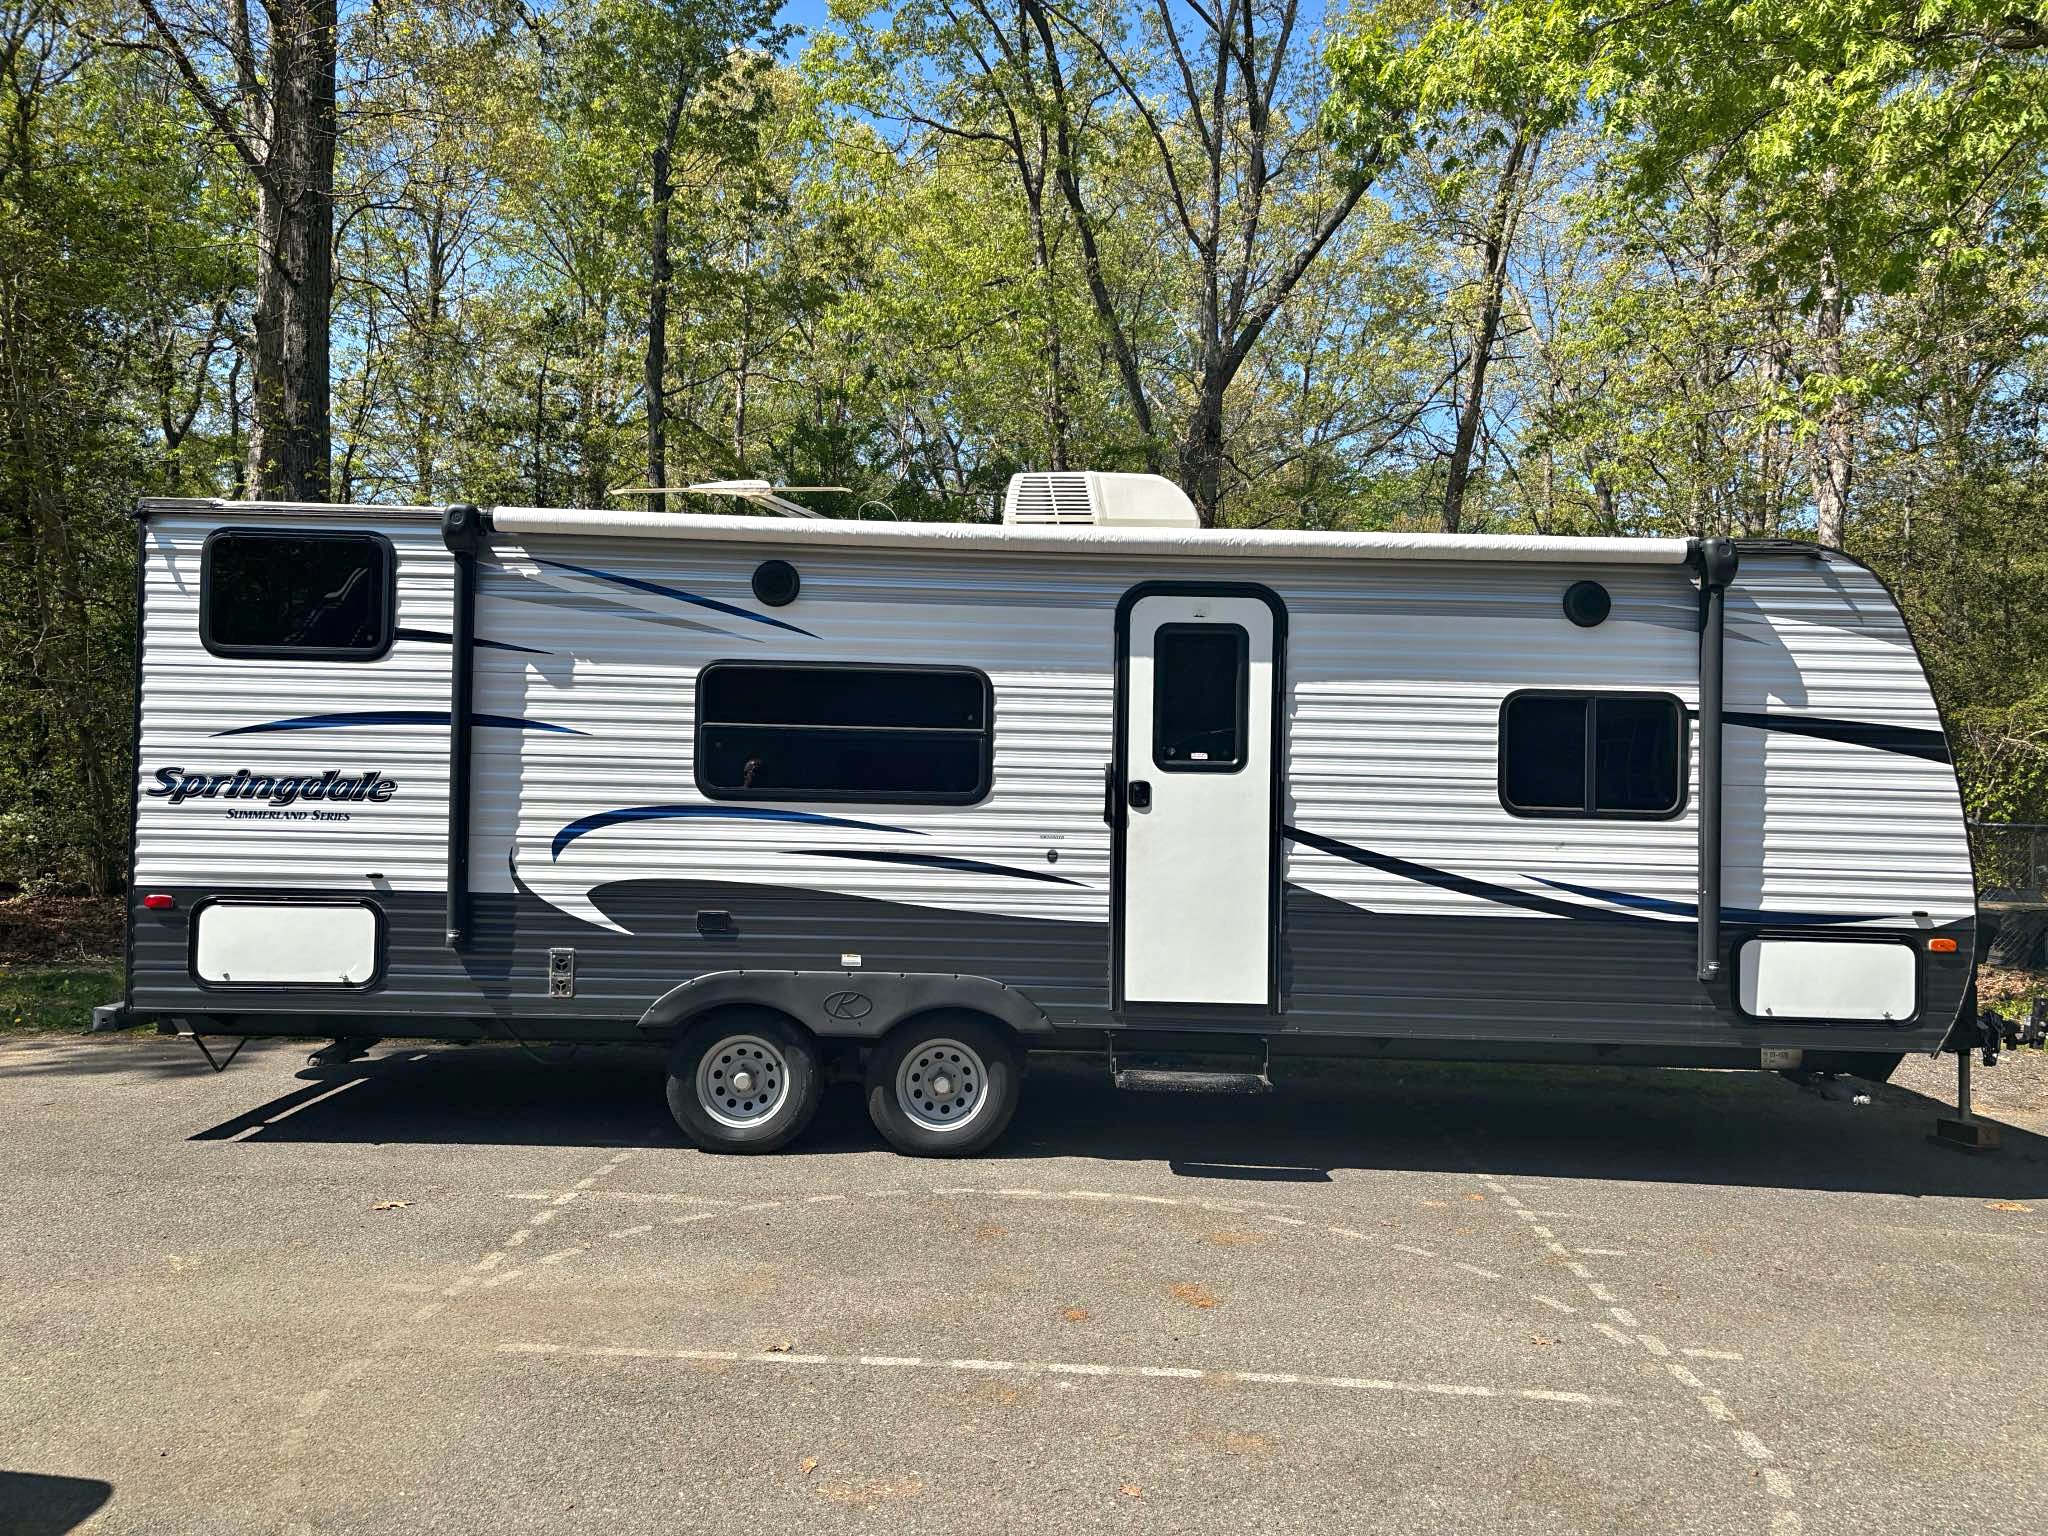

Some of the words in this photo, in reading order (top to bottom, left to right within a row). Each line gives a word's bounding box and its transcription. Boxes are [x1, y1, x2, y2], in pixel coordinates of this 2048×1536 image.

[146, 767, 398, 806] Springdale
[225, 808, 308, 820] SUMMERLAND
[311, 809, 351, 821] SERIES
